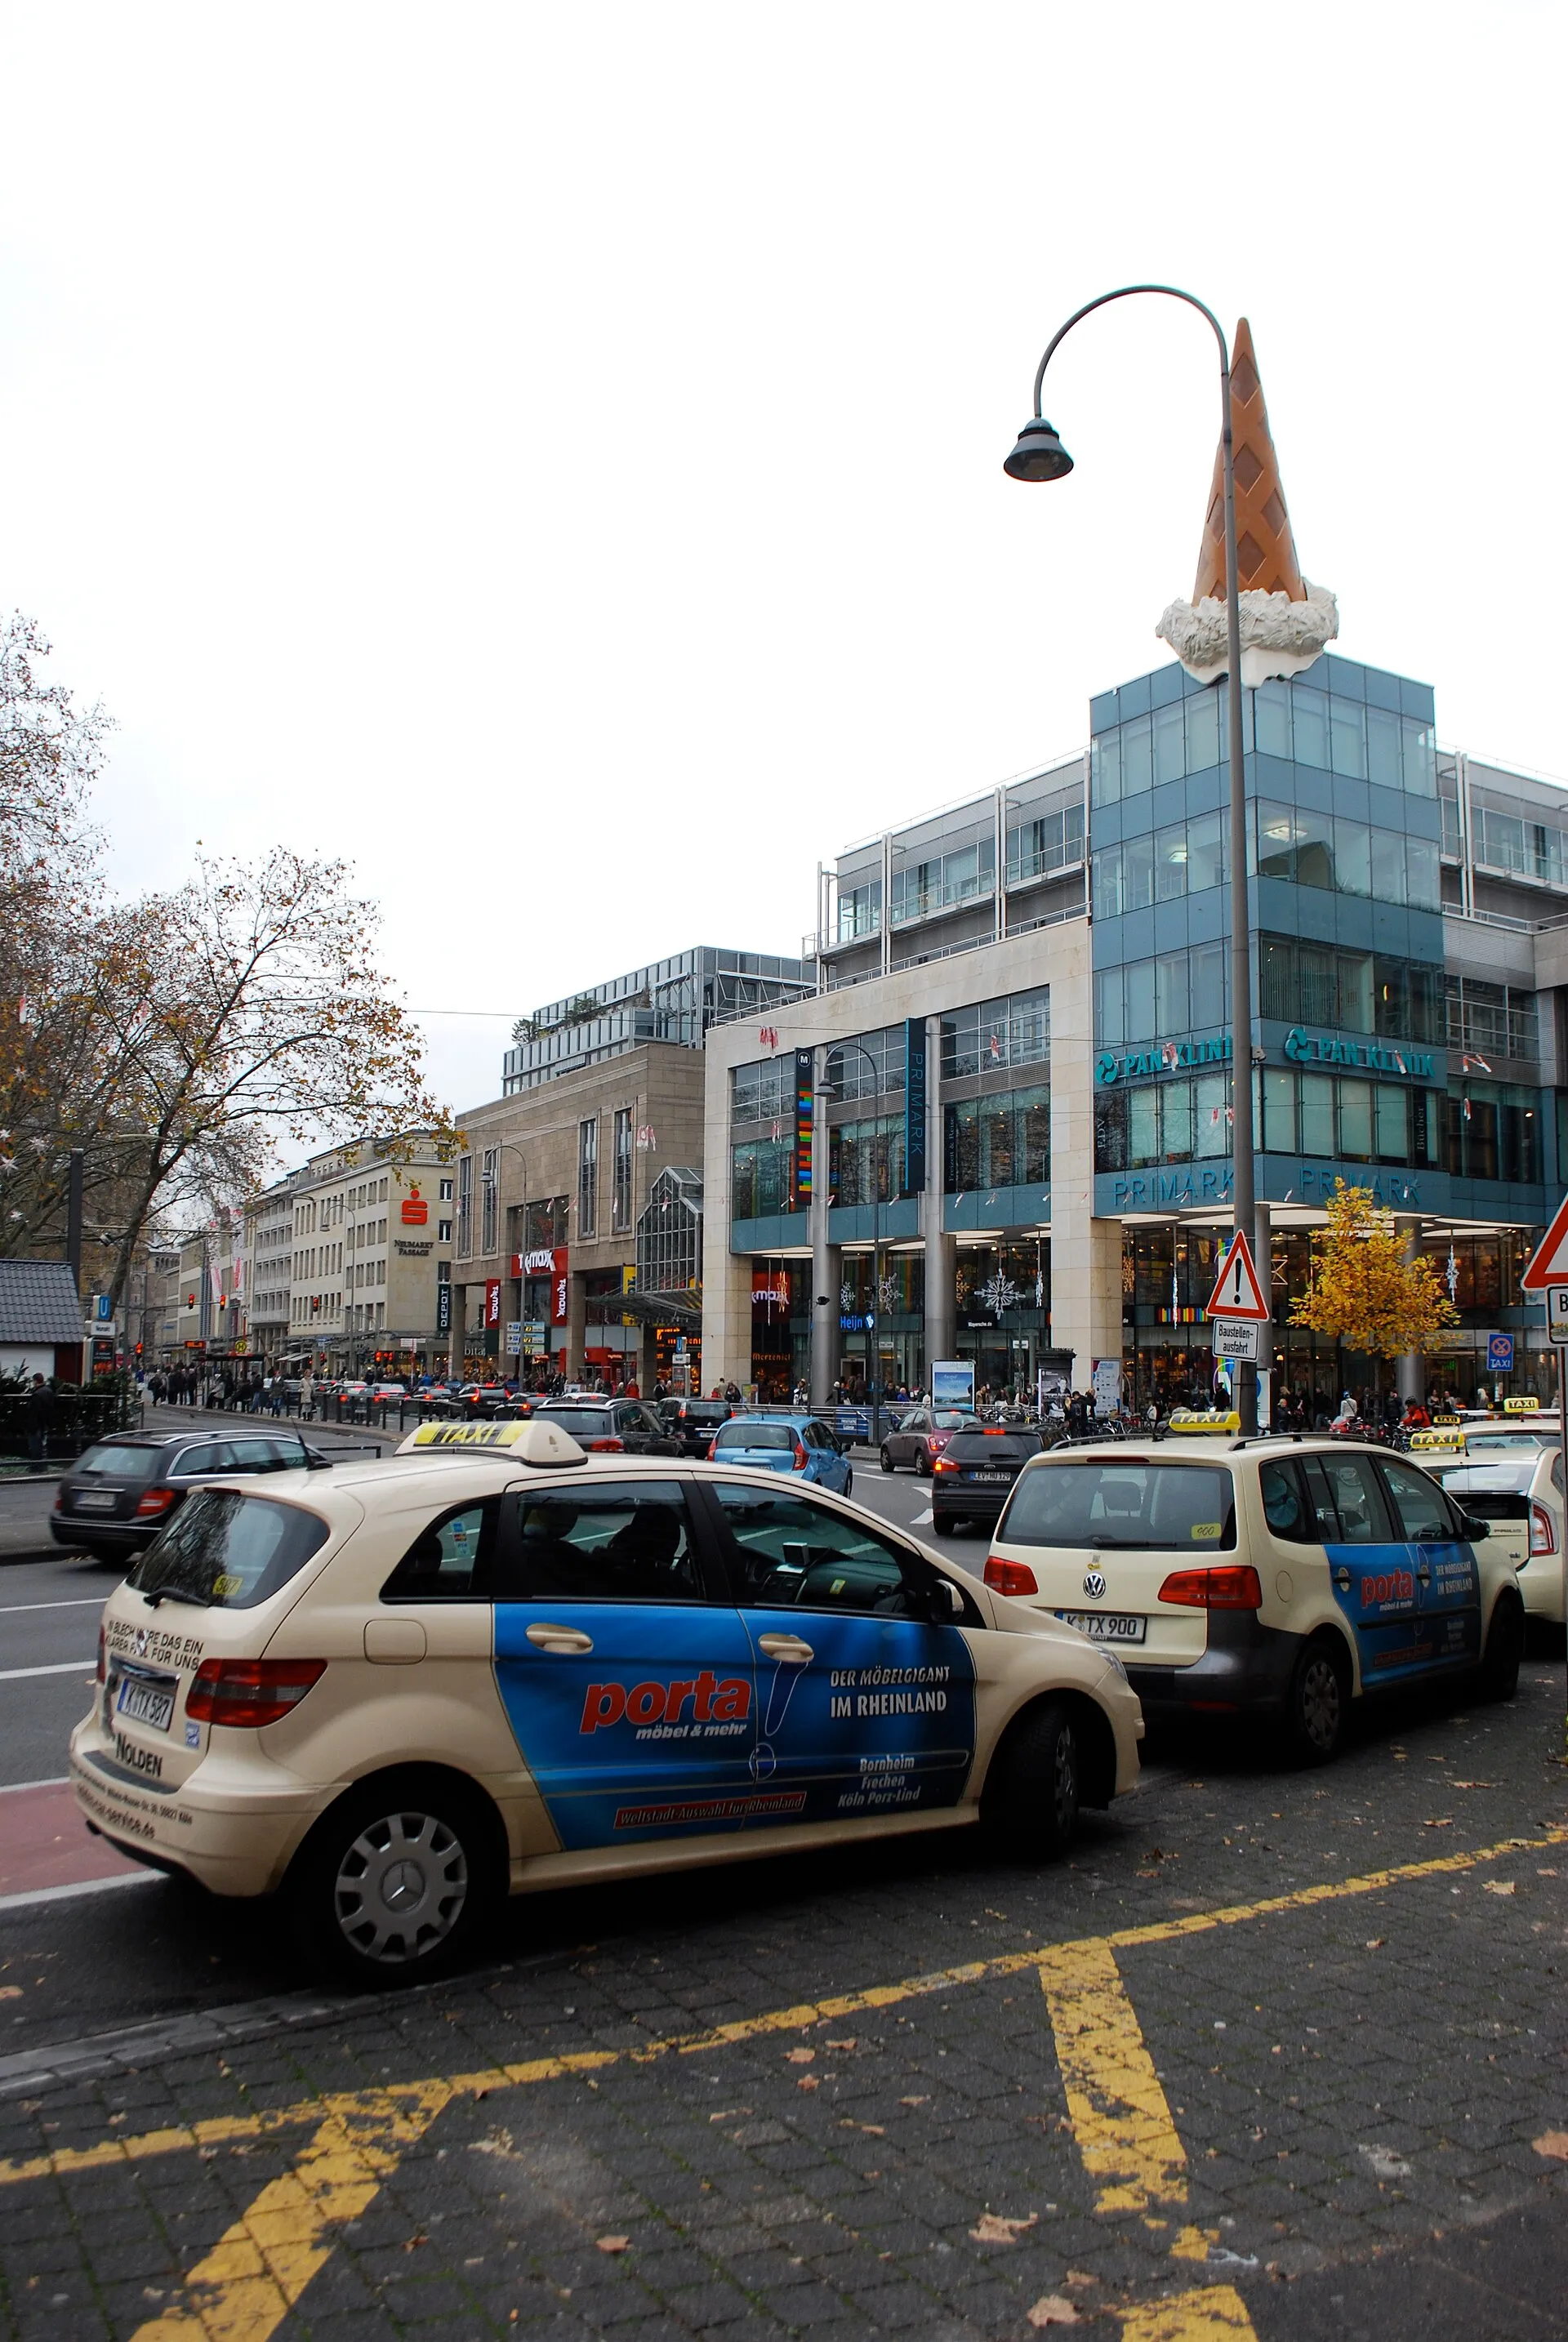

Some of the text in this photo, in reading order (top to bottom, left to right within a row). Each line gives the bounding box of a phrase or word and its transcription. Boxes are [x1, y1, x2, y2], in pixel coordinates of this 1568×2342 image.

[1318, 1036, 1358, 1066] PAN
[1125, 1048, 1164, 1077] PAN
[911, 1053, 923, 1155] PRIMARK
[1417, 1106, 1425, 1151] Bücher
[1113, 1168, 1235, 1207] PRIMARK
[394, 1240, 434, 1249] NEUMARKT
[399, 1248, 430, 1257] PASSAGE
[440, 1289, 448, 1327] DEPOT
[840, 1315, 863, 1332] Heijn
[1218, 1324, 1254, 1339] Baustellen-
[1223, 1341, 1249, 1355] ausfahrt
[1490, 1358, 1511, 1369] TAXI
[1510, 1400, 1534, 1409] TAXI
[1179, 1414, 1221, 1423] TAXI
[440, 1424, 498, 1444] TAXI
[1419, 1435, 1453, 1444] TAXI
[1196, 1526, 1214, 1536] 900
[1361, 1567, 1414, 1609] porta
[1087, 1617, 1106, 1634] TX
[1109, 1618, 1137, 1636] 900
[114, 1622, 136, 1637] BLECH
[161, 1633, 182, 1650] DAS
[184, 1639, 204, 1655] EIN
[105, 1635, 129, 1652] KLARER
[151, 1647, 172, 1665] FÜR
[174, 1654, 200, 1672] UNS
[830, 1665, 950, 1687] DER MÖBELGIGANT
[137, 1690, 152, 1719] TX
[149, 1694, 171, 1725] 587
[579, 1671, 752, 1735] porta
[831, 1690, 947, 1719] IM RHEINLAND
[635, 1723, 747, 1740] möbel & mehr
[115, 1733, 163, 1777] NOLDEN
[859, 1753, 915, 1773] Bornheim
[861, 1773, 906, 1791] Frechen
[748, 1795, 804, 1811] Rheinland
[838, 1785, 921, 1808] Köln Porz-Lind
